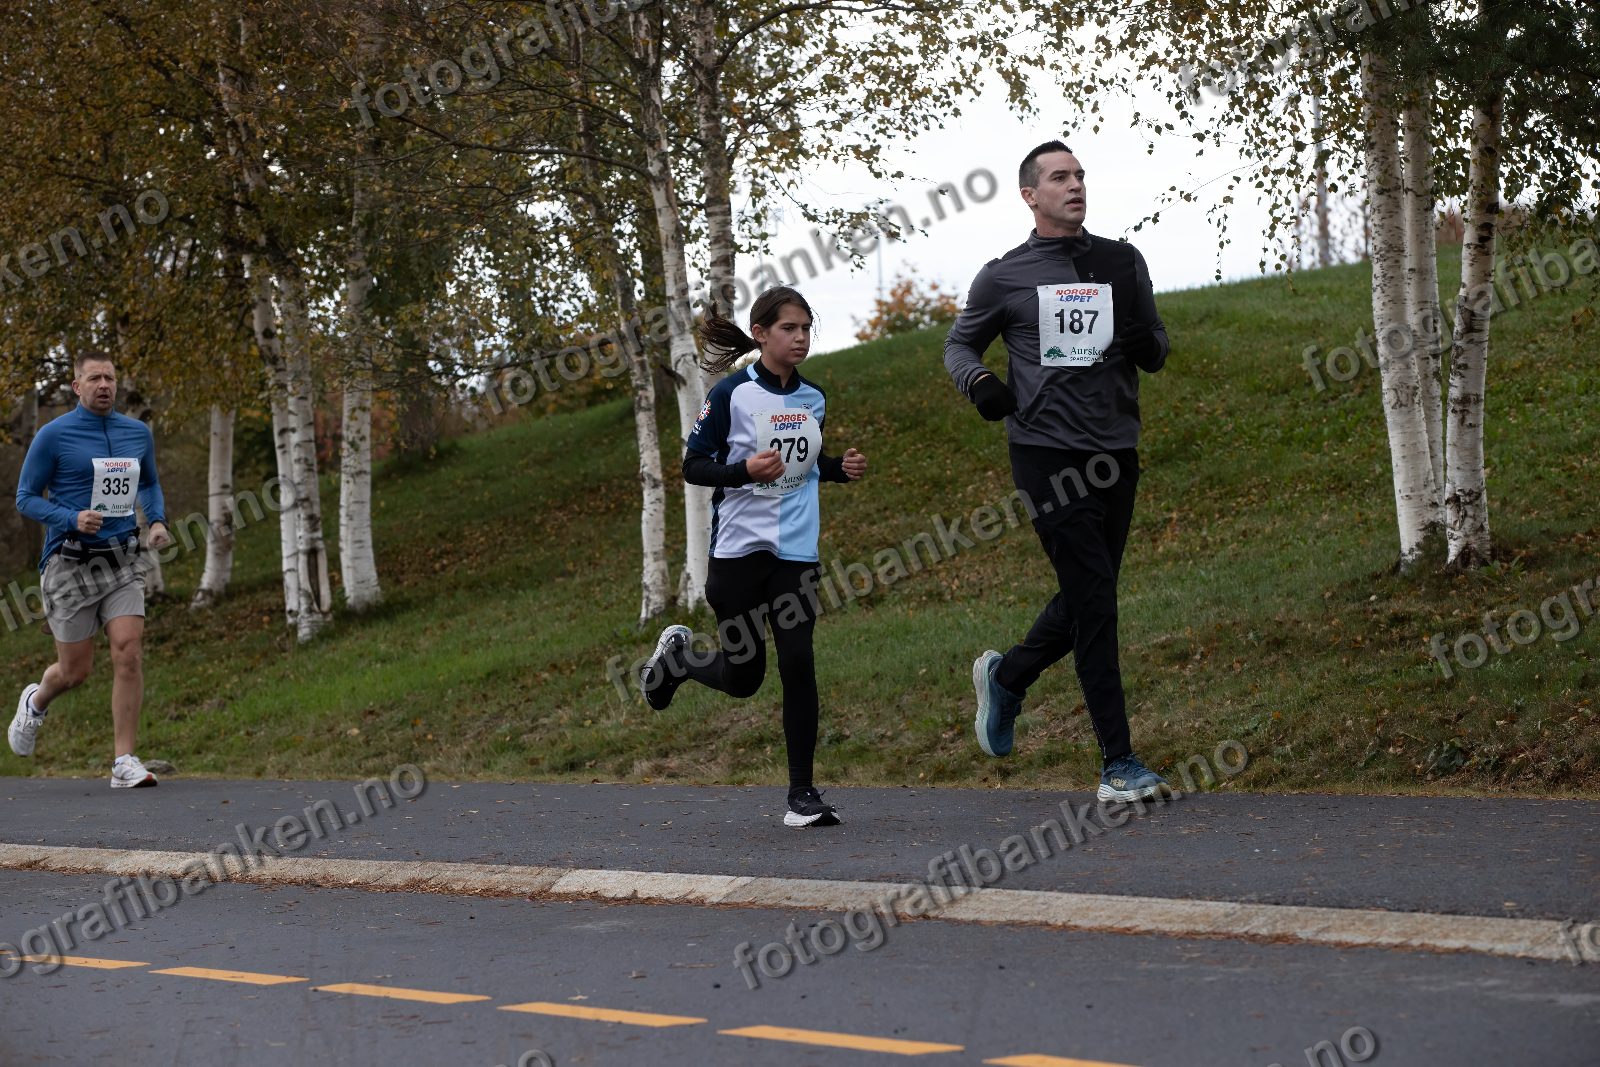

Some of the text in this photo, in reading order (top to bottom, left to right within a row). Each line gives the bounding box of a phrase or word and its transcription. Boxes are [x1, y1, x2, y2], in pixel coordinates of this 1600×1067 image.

[1056, 288, 1099, 296] NORGES
[1054, 308, 1099, 335] 187
[769, 413, 808, 423] NORGES
[774, 422, 803, 431] LØPET
[101, 477, 130, 495] 335
